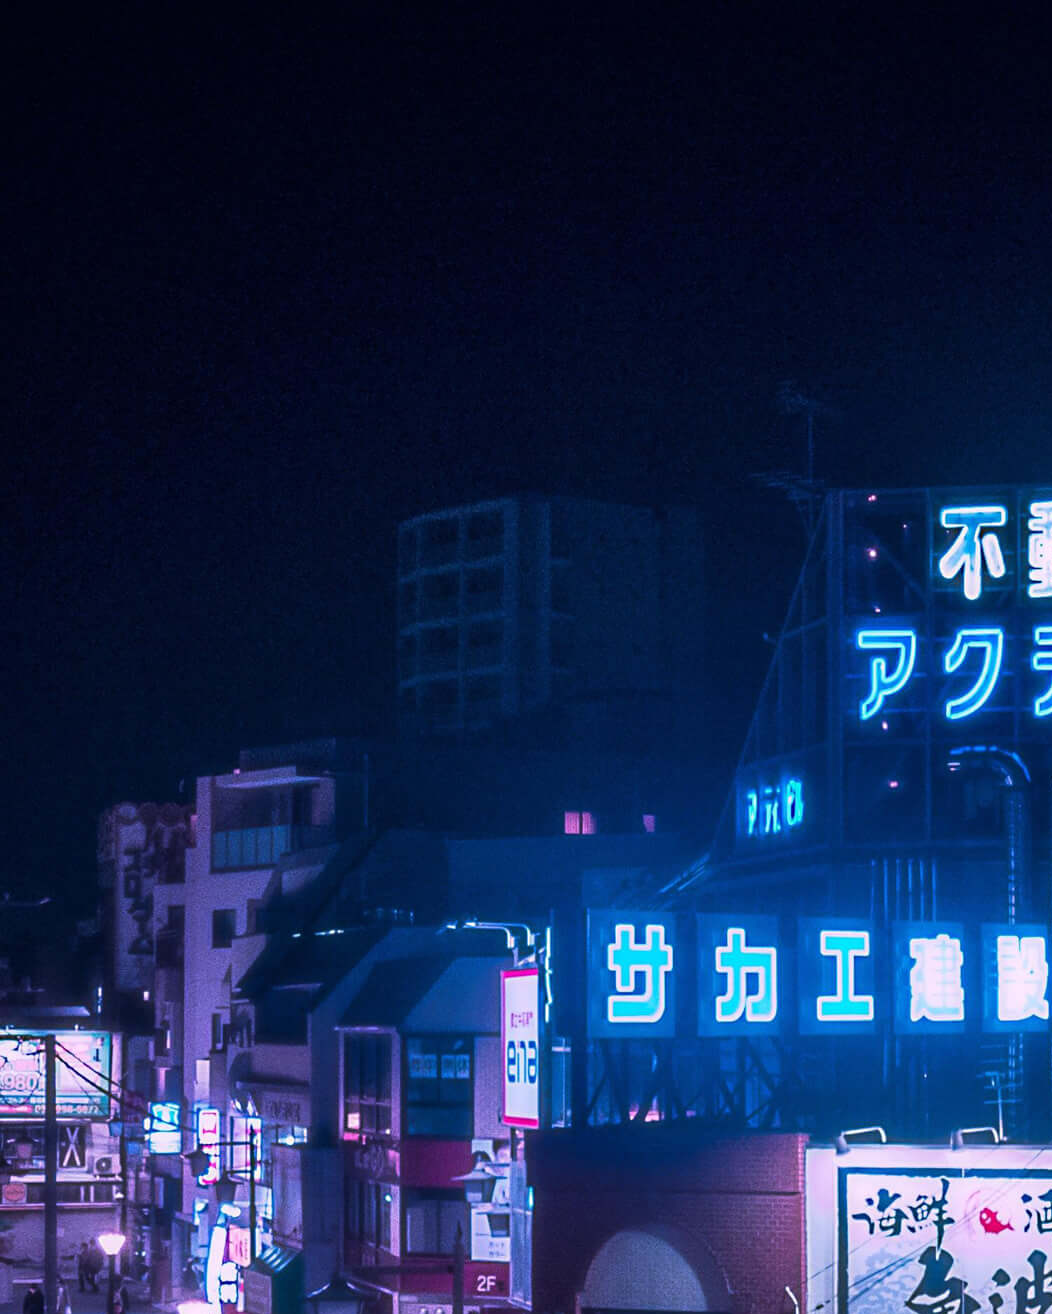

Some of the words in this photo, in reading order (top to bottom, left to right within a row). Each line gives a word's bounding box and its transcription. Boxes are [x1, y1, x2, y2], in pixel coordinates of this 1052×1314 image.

[507, 1040, 537, 1083] ena
[852, 1177, 955, 1248] 海鮮
[476, 1275, 497, 1292] 2F
